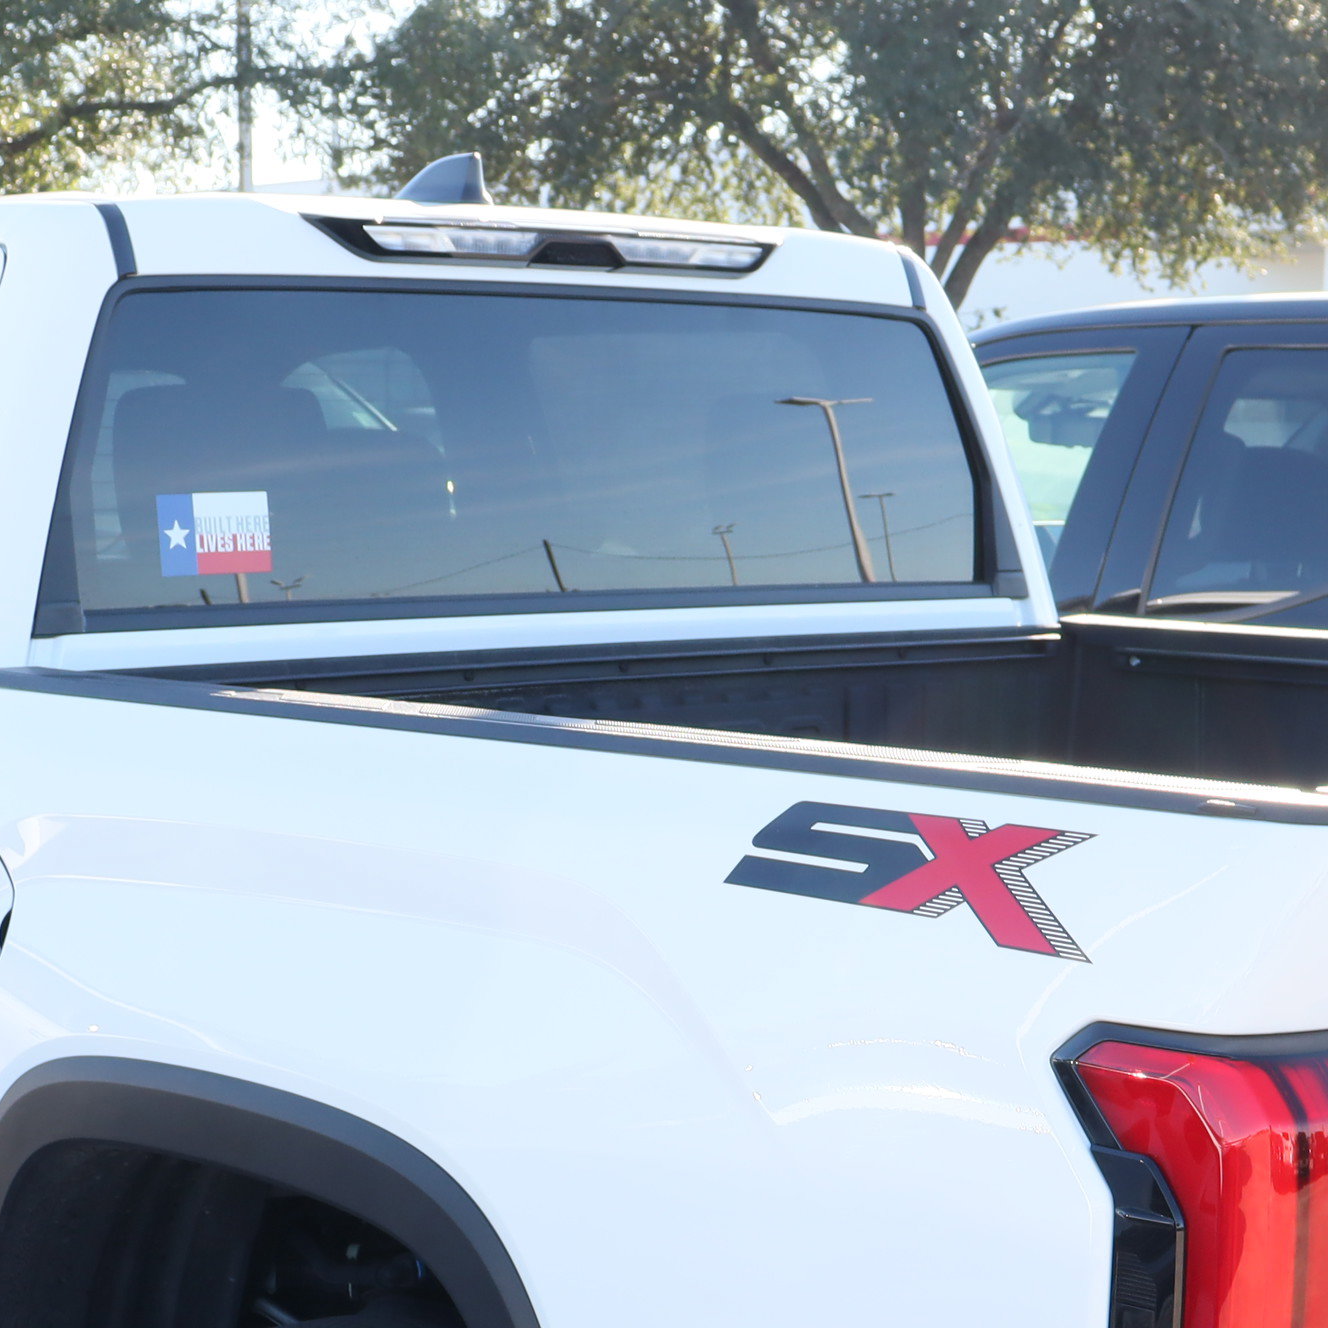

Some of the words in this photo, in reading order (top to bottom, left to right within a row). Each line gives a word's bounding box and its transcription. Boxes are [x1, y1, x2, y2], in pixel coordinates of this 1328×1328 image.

[195, 515, 232, 534] BUILT
[236, 514, 269, 532] HERE
[196, 534, 234, 552] LIVES
[237, 533, 271, 551] HERE
